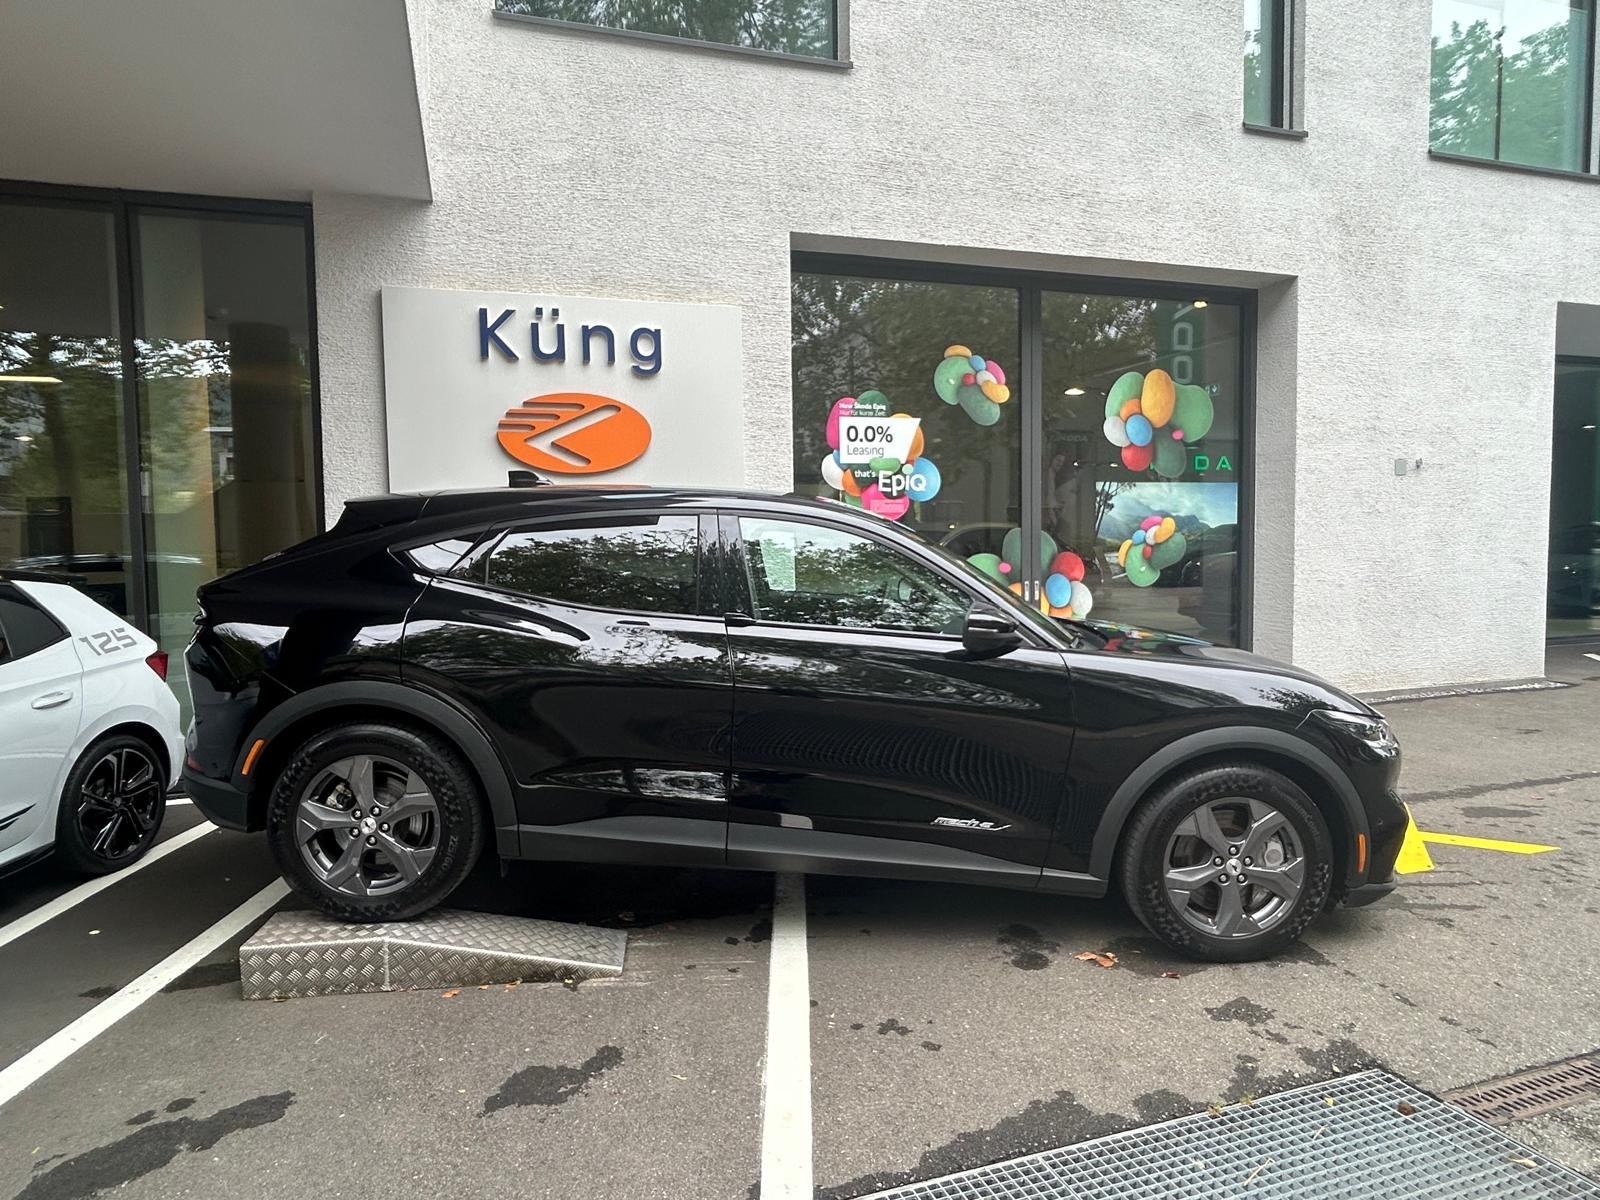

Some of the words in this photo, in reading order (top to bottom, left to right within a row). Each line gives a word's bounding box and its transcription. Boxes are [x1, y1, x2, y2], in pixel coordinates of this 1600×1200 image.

[478, 306, 664, 377] Küng
[846, 425, 893, 443] 0.0%
[847, 445, 884, 458] Leasing
[854, 469, 876, 478] that's
[78, 627, 138, 657] 125
